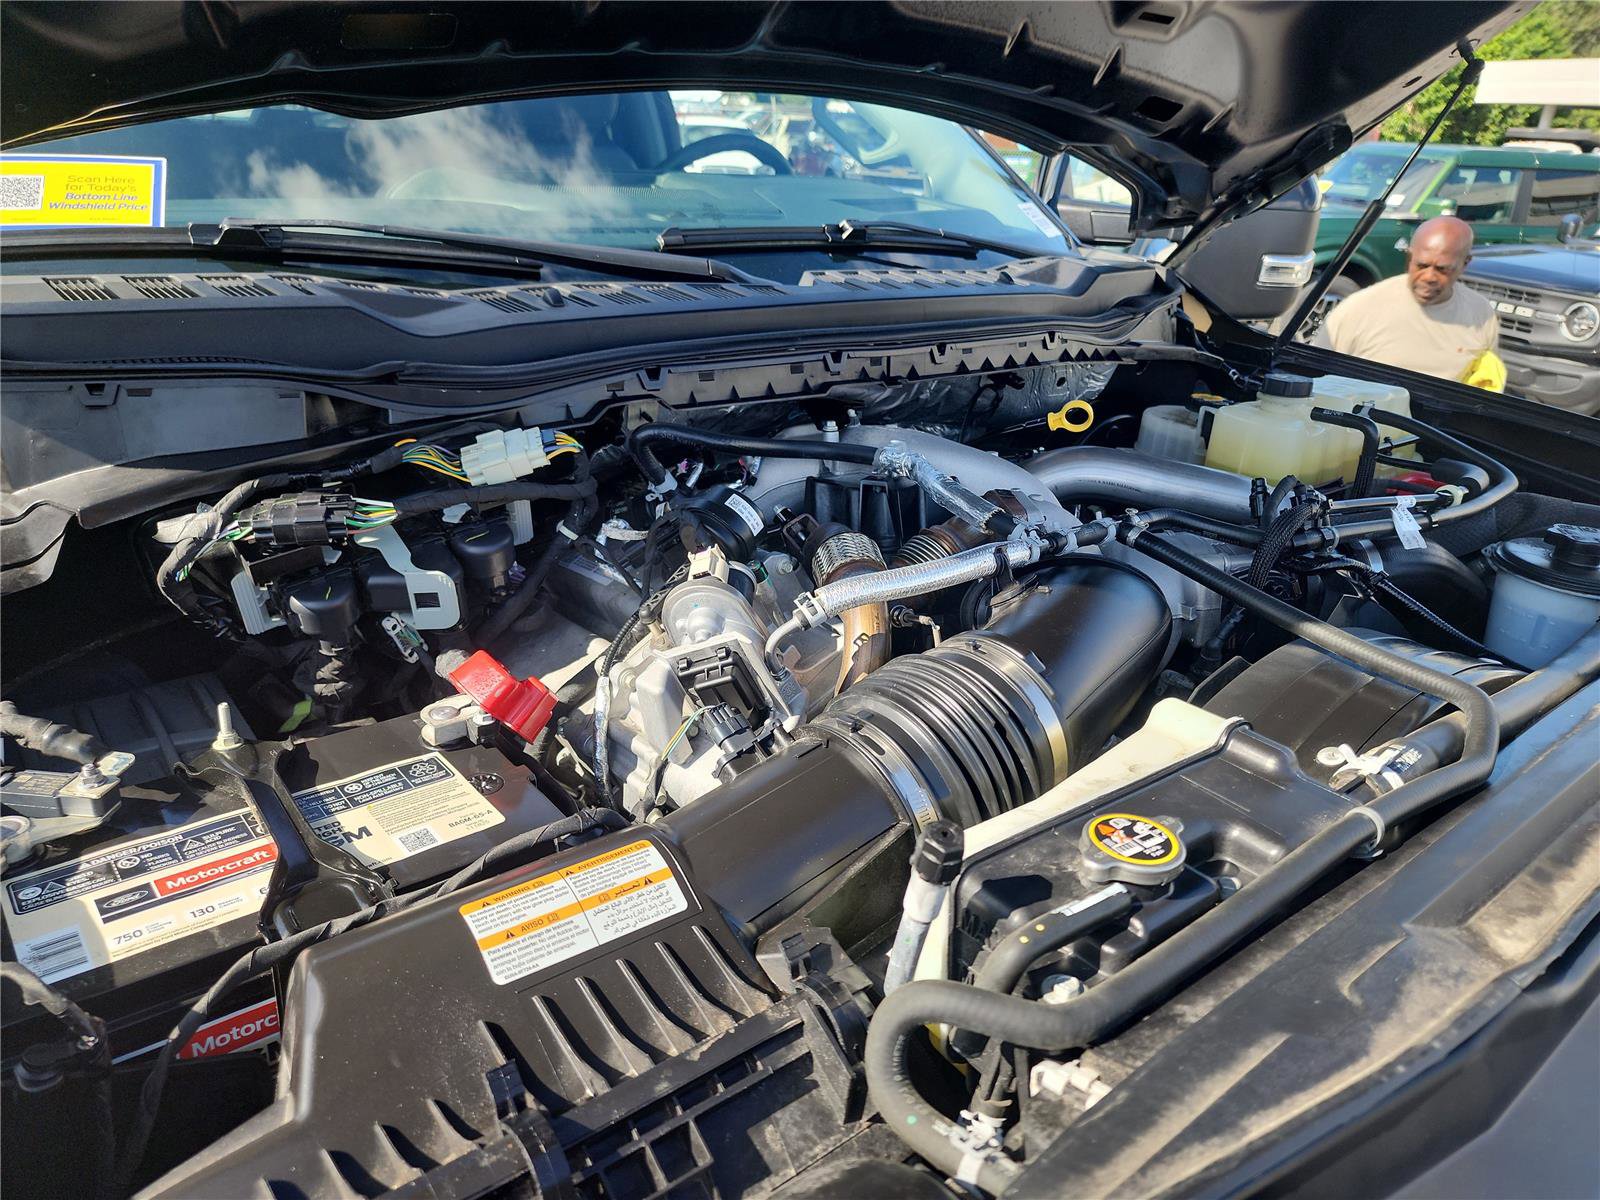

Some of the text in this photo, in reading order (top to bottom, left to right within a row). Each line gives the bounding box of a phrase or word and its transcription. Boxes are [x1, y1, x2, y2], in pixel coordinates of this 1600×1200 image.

[67, 175, 135, 184] Scan Here
[65, 183, 137, 193] for Today's
[65, 192, 138, 201] Bottom Line
[49, 202, 147, 211] Windshield Price
[204, 835, 221, 844] ACID
[90, 832, 182, 867] DANGER/POISON
[140, 852, 152, 860] NO
[576, 847, 633, 870] AVERTISSEMENT
[166, 849, 271, 891] Motorcraft
[494, 885, 530, 902] WARNING
[189, 905, 215, 918] 130
[519, 918, 544, 932] AVISO
[113, 929, 143, 945] 750
[192, 1015, 279, 1058] Motorc
